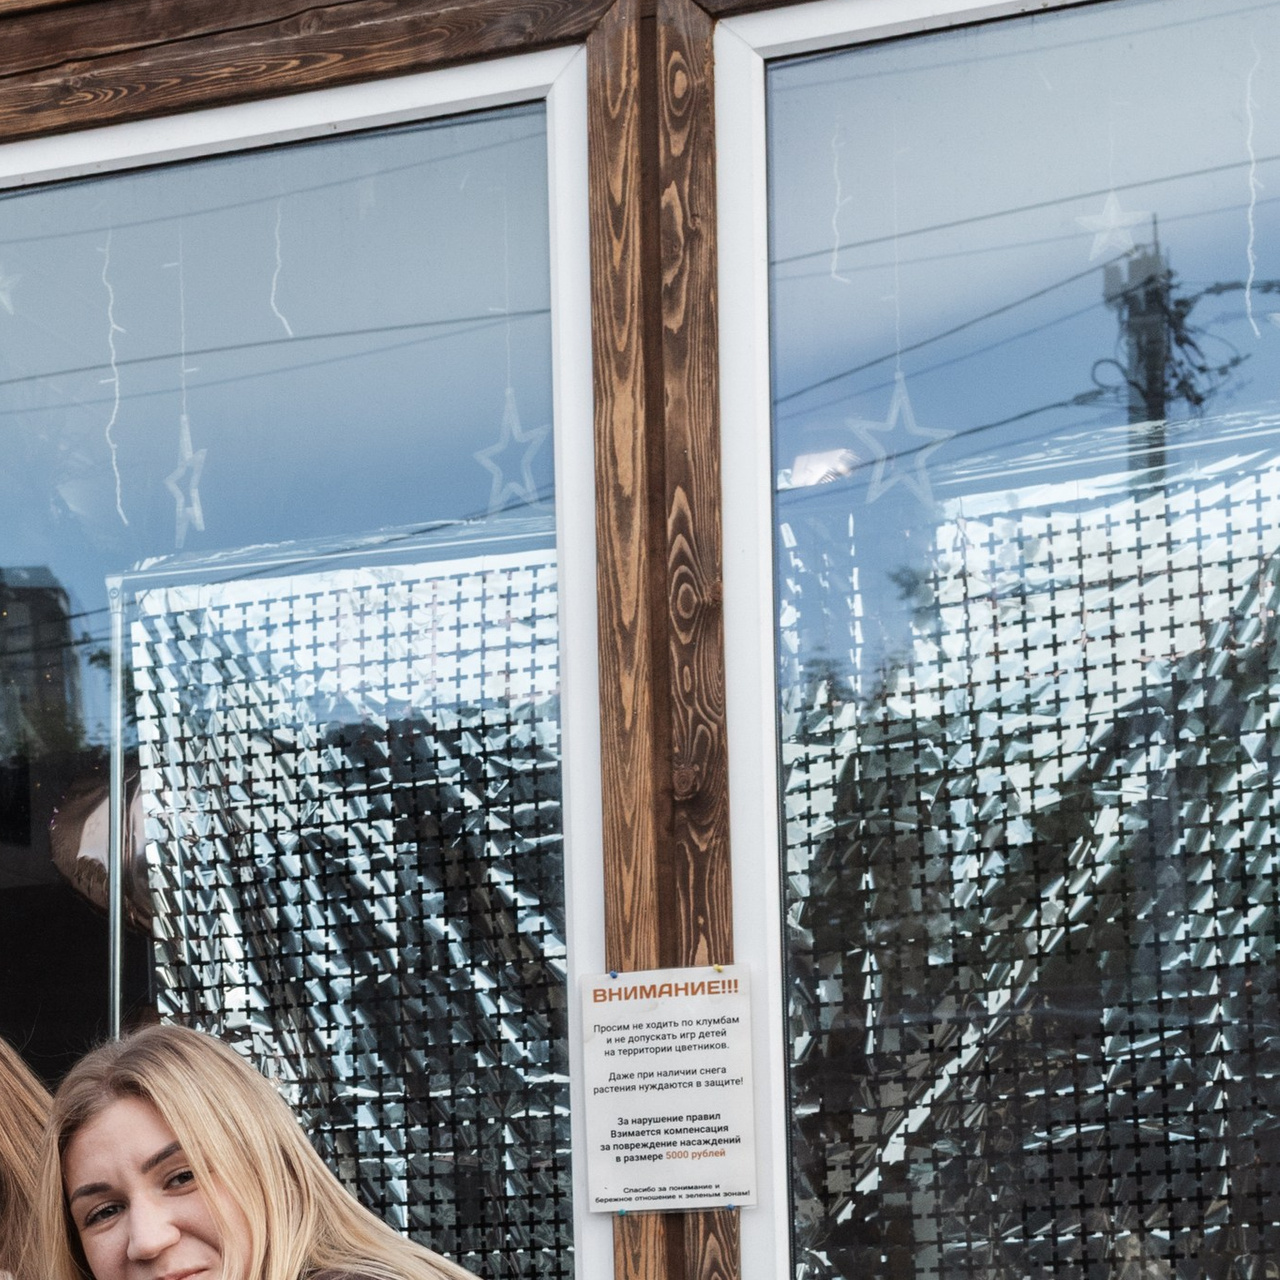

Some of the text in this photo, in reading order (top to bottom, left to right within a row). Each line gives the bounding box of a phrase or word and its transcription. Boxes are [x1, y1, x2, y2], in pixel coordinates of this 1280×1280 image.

[593, 979, 739, 1003] ВНИМАНИЕ!!!
[594, 1024, 630, 1034] Просим
[646, 1020, 679, 1030] ходить
[696, 1016, 739, 1028] клумбам
[628, 1033, 677, 1045] допускать
[680, 1031, 695, 1041] игр
[698, 1028, 726, 1039] детей
[618, 1045, 672, 1056] территории
[675, 1041, 729, 1053] цветников.
[608, 1066, 726, 1082] Даже при наличии снега
[593, 1083, 636, 1095] растения
[639, 1081, 693, 1092] нуждаются
[704, 1077, 743, 1088] защите!
[618, 1113, 721, 1126] За нарушение правил
[610, 1125, 728, 1138] Взимается компенсация
[613, 1139, 677, 1152] повреждение
[680, 1135, 741, 1147] насаждений
[624, 1153, 663, 1163] размере
[666, 1150, 689, 1159] 5000
[692, 1148, 726, 1160] рублей
